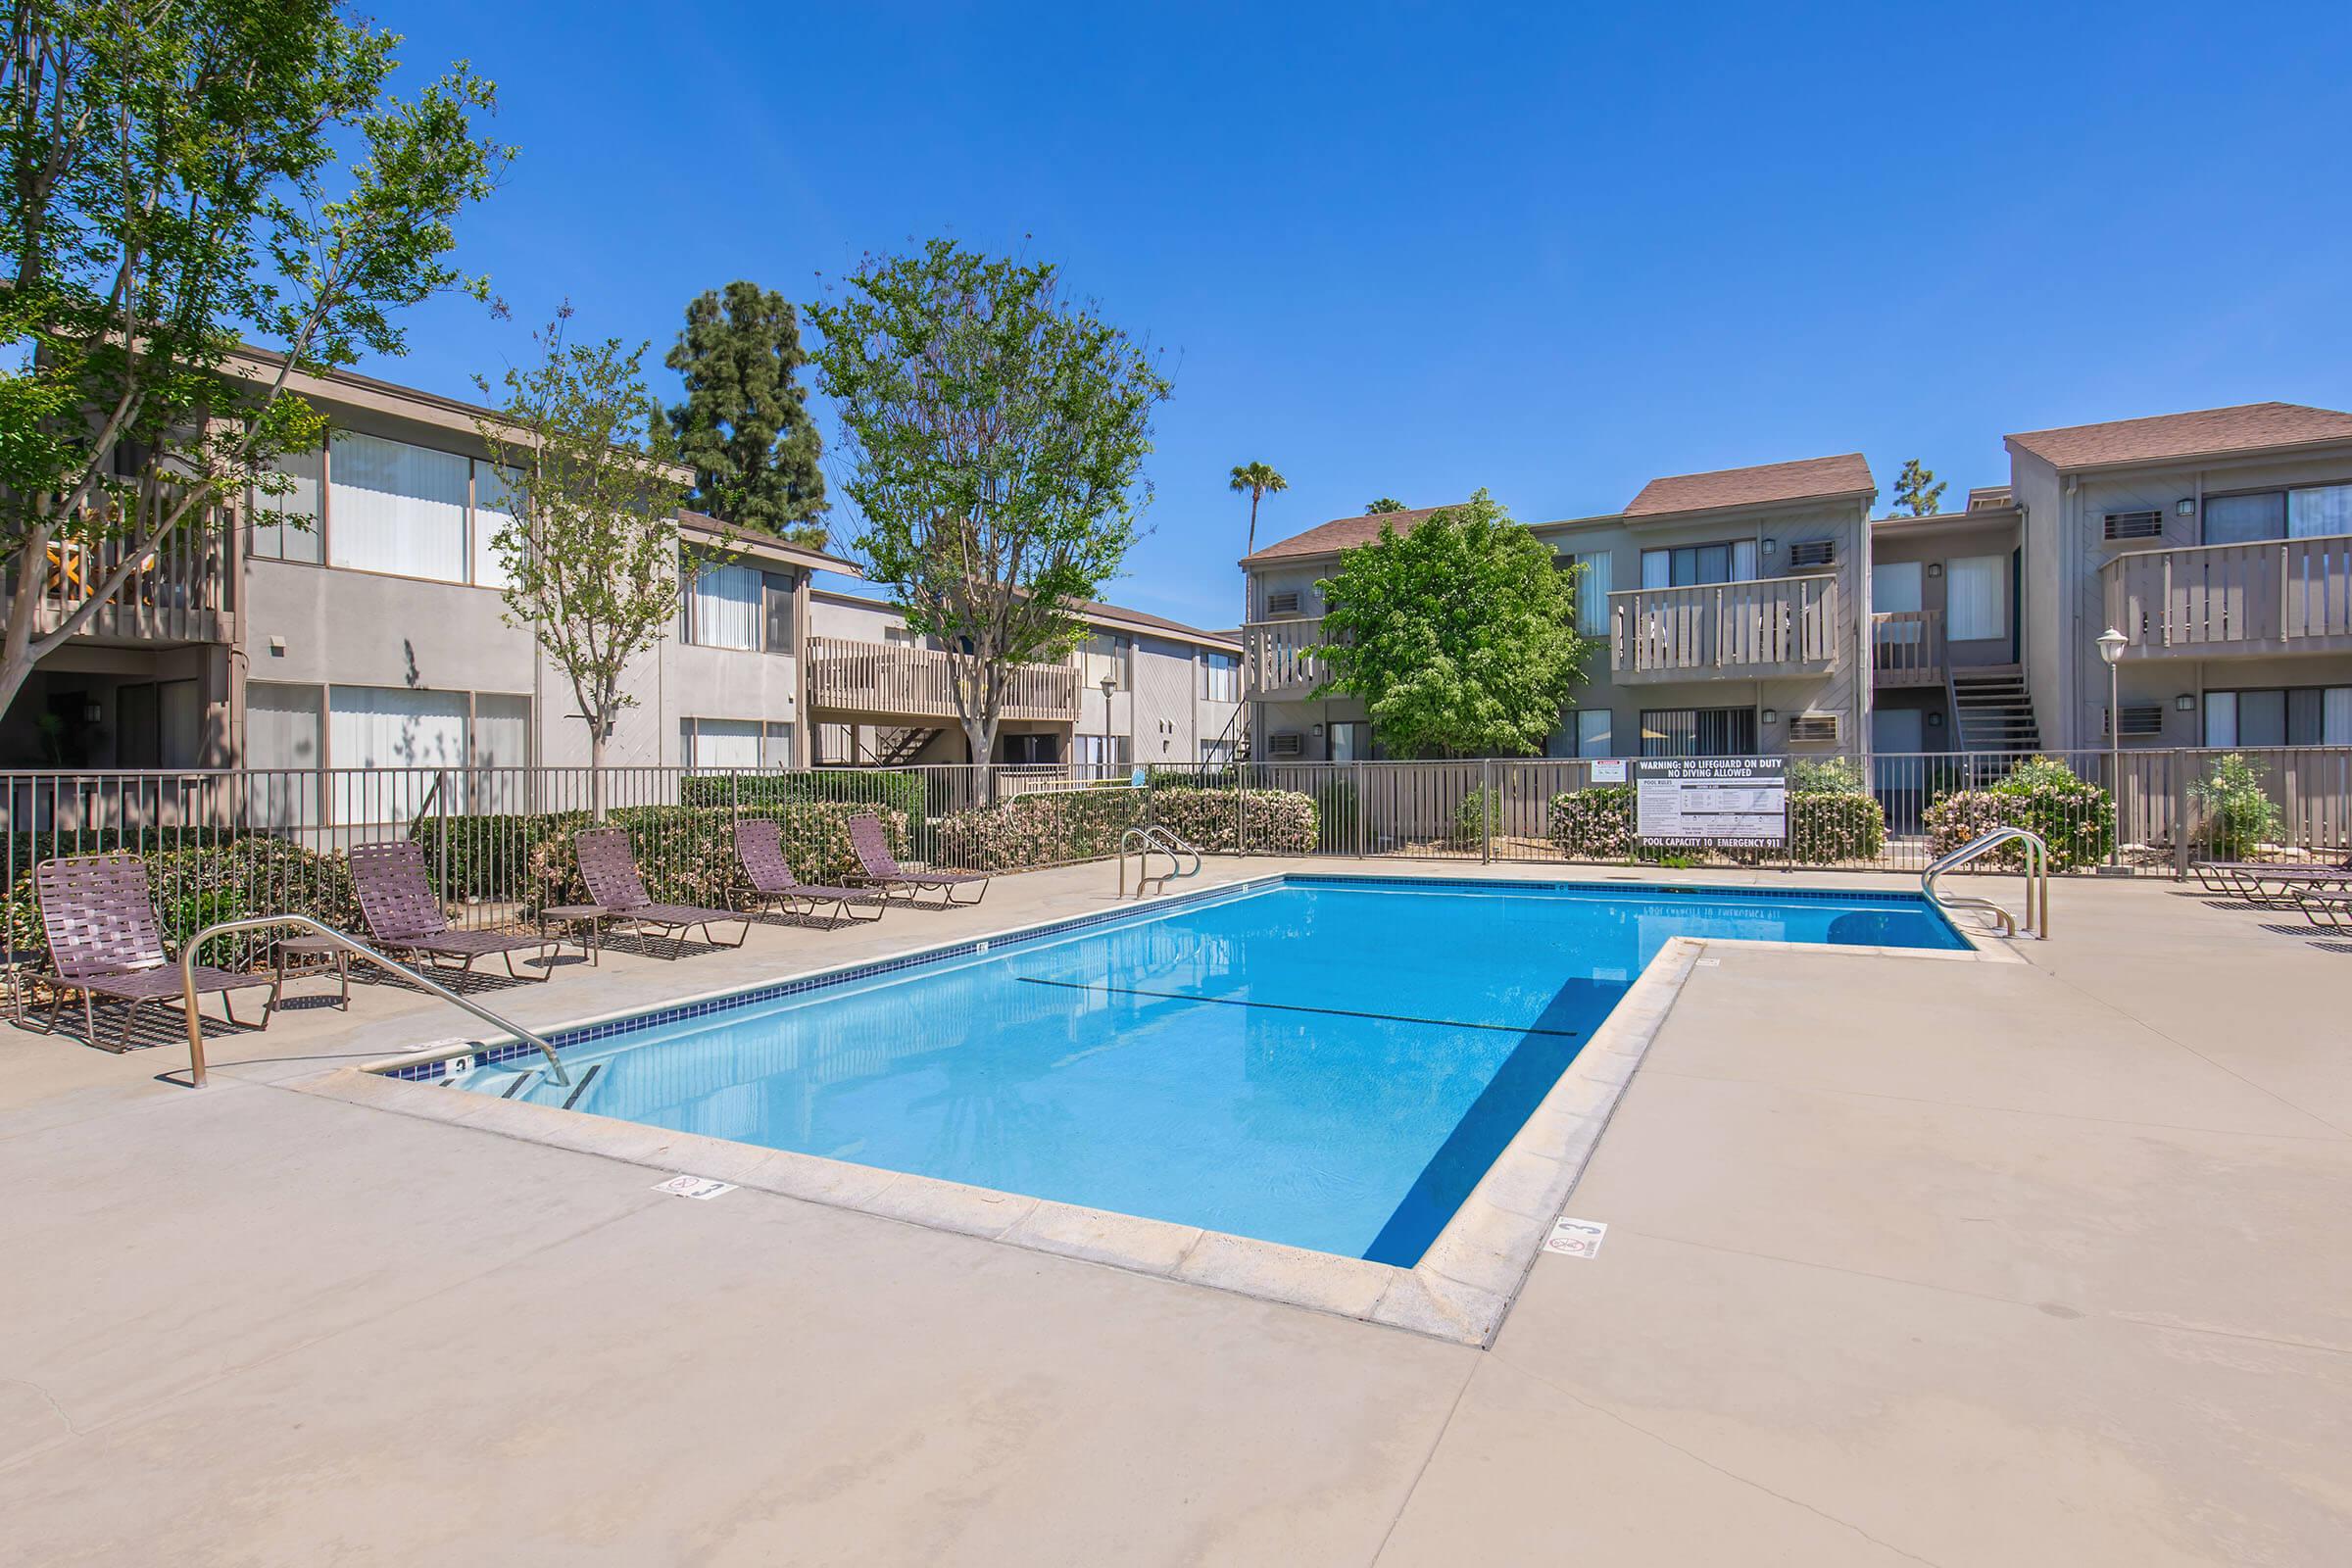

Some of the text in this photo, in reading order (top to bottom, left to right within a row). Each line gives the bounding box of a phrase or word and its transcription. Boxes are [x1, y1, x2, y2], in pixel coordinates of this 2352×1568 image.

[1640, 759, 1782, 769] WARNING: NO LIFEGUARD ON DUTY
[1668, 768, 1752, 778] NO DIVING ALLOWED
[1642, 837, 1780, 848] POOL CAPACITY 10 EMERGENCY 911
[691, 1183, 724, 1197] 3
[1558, 1223, 1601, 1235] 3
